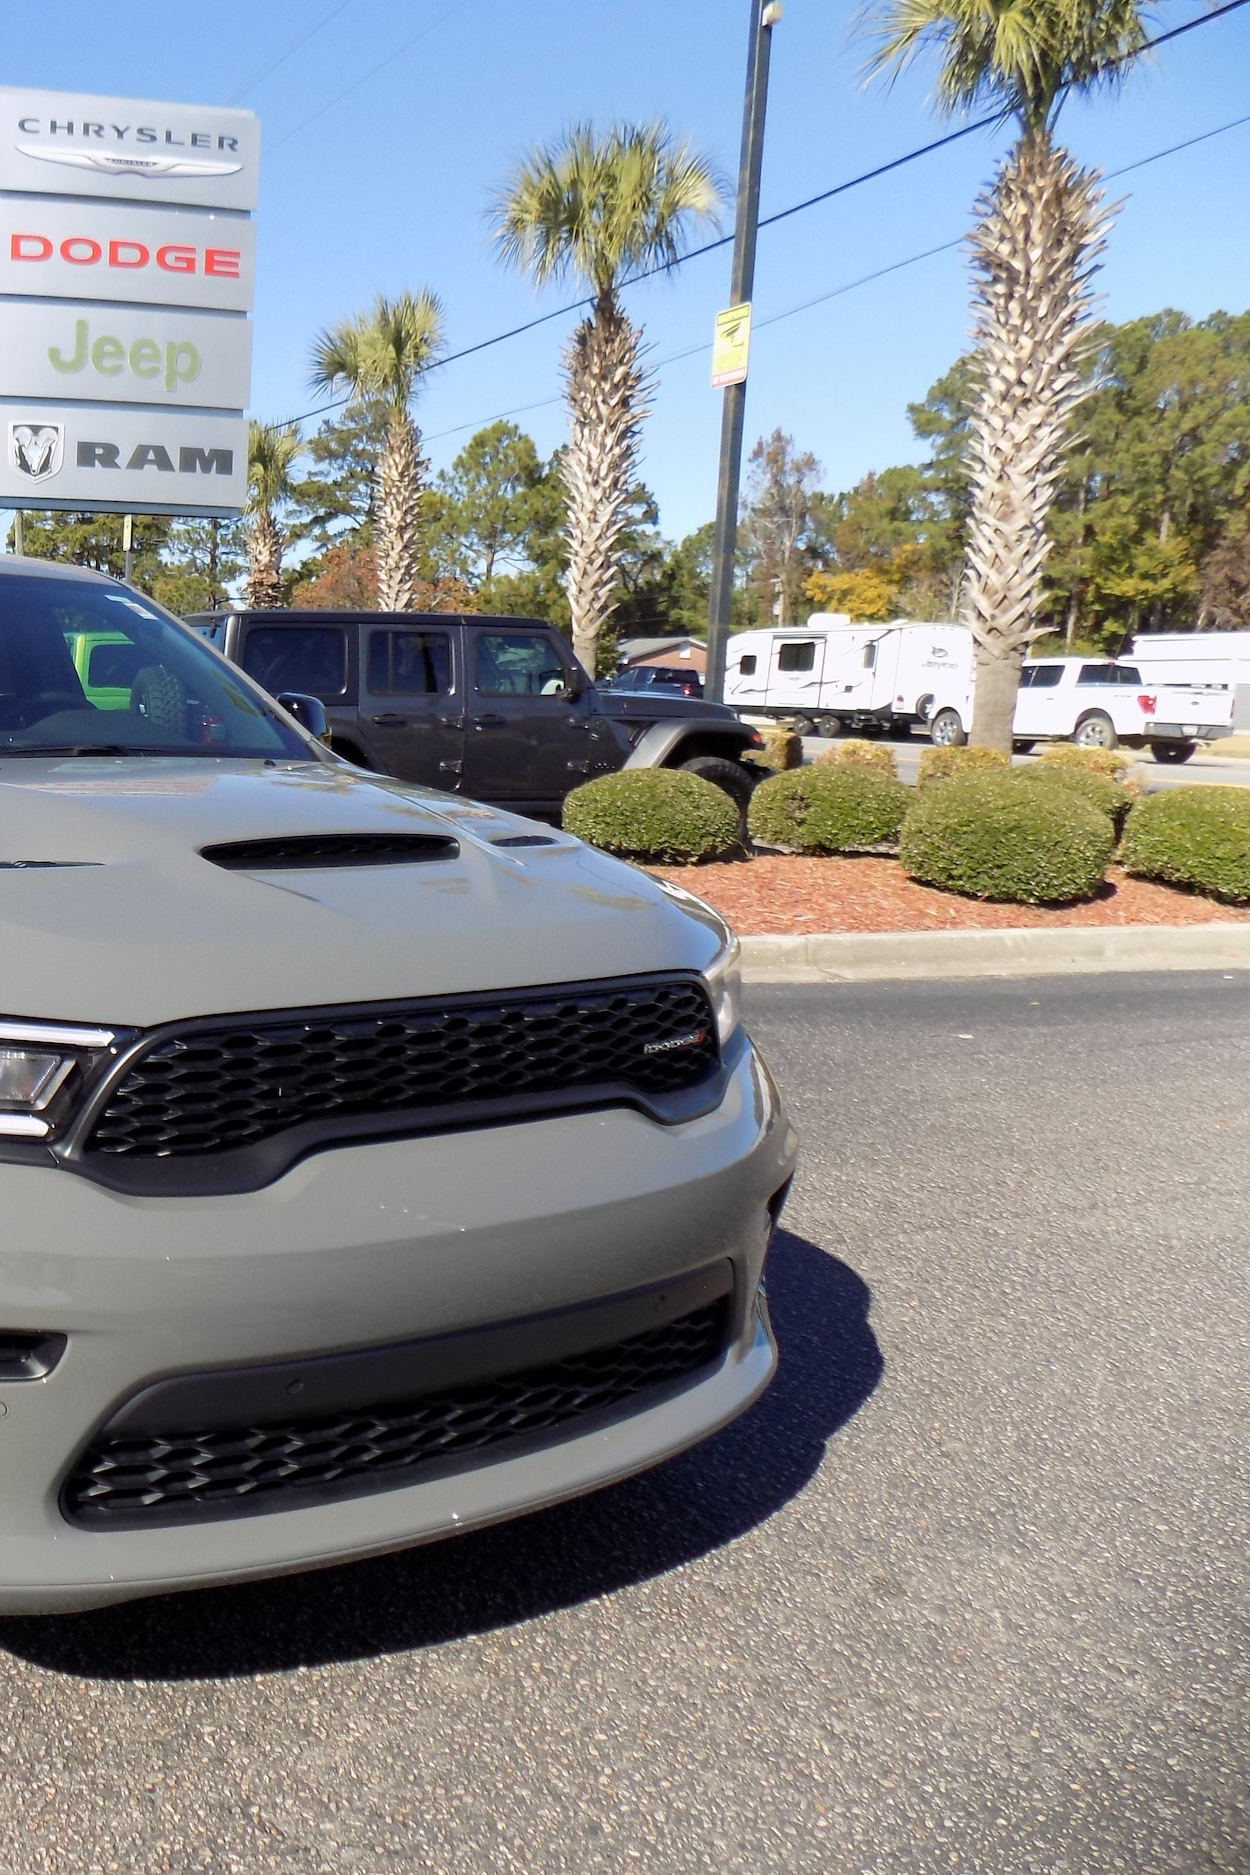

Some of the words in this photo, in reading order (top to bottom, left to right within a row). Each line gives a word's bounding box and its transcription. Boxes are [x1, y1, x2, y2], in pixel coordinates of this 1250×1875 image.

[18, 118, 239, 153] CHRYSLER
[10, 233, 242, 279] DODGE
[48, 319, 202, 393] Jeep
[76, 440, 234, 476] RAM
